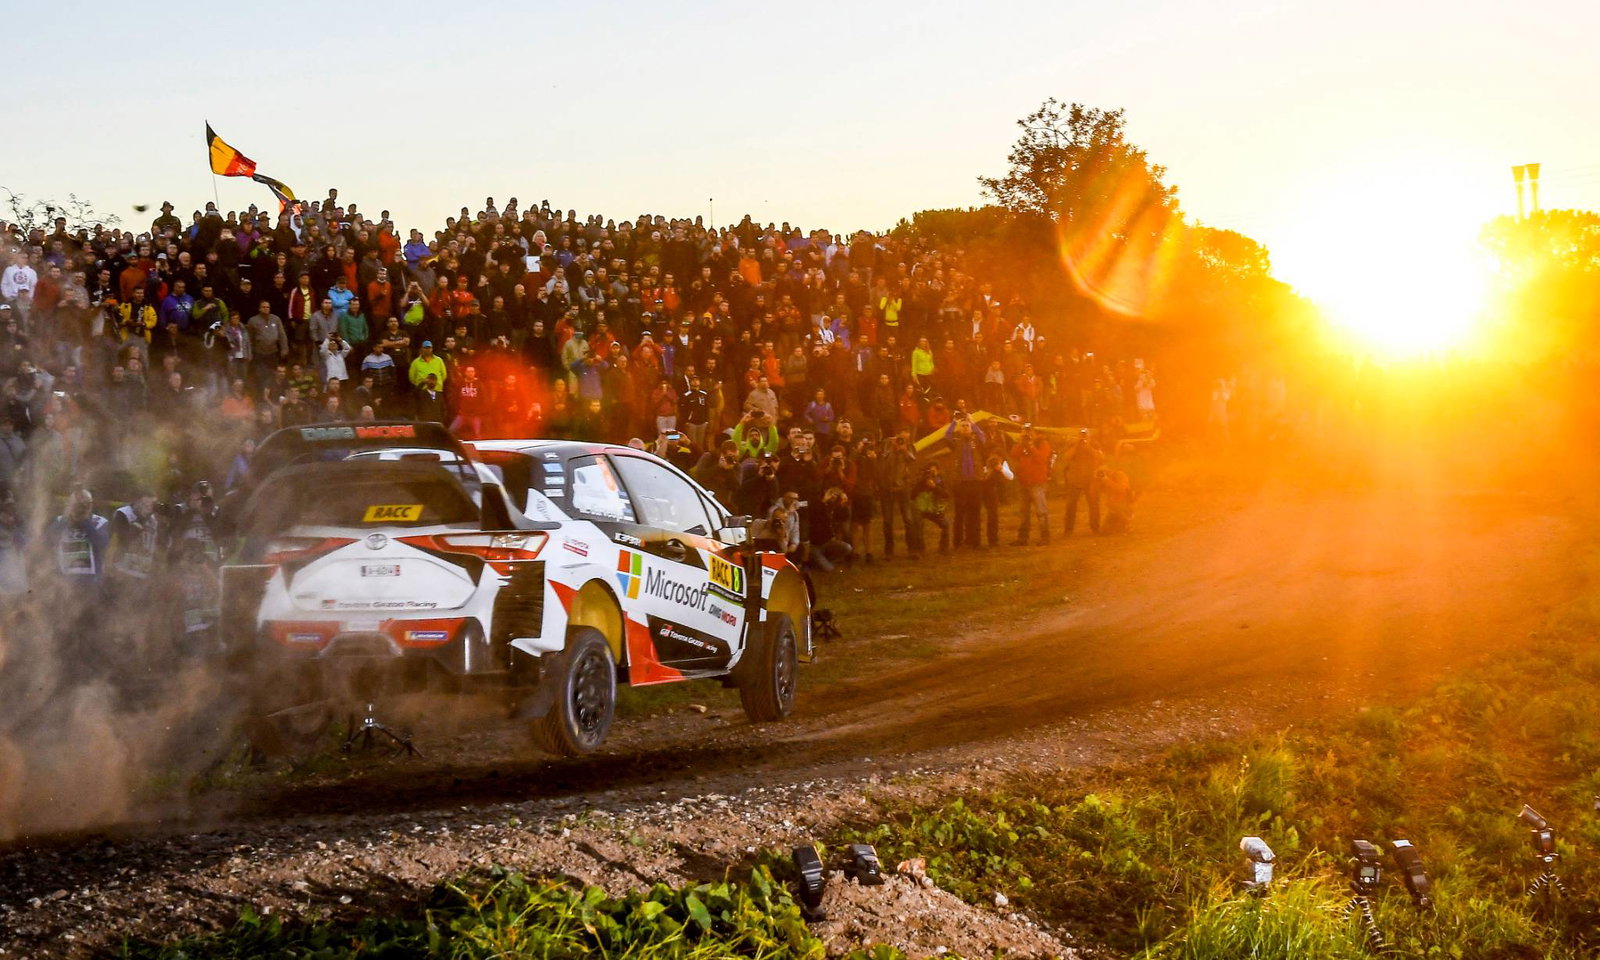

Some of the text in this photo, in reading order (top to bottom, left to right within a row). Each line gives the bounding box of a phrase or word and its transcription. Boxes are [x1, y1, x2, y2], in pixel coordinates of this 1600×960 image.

[373, 507, 412, 518] RACC
[712, 557, 730, 587] RACC
[733, 566, 740, 592] 8
[645, 566, 708, 611] Microsoft
[709, 604, 737, 627] DMG MORI
